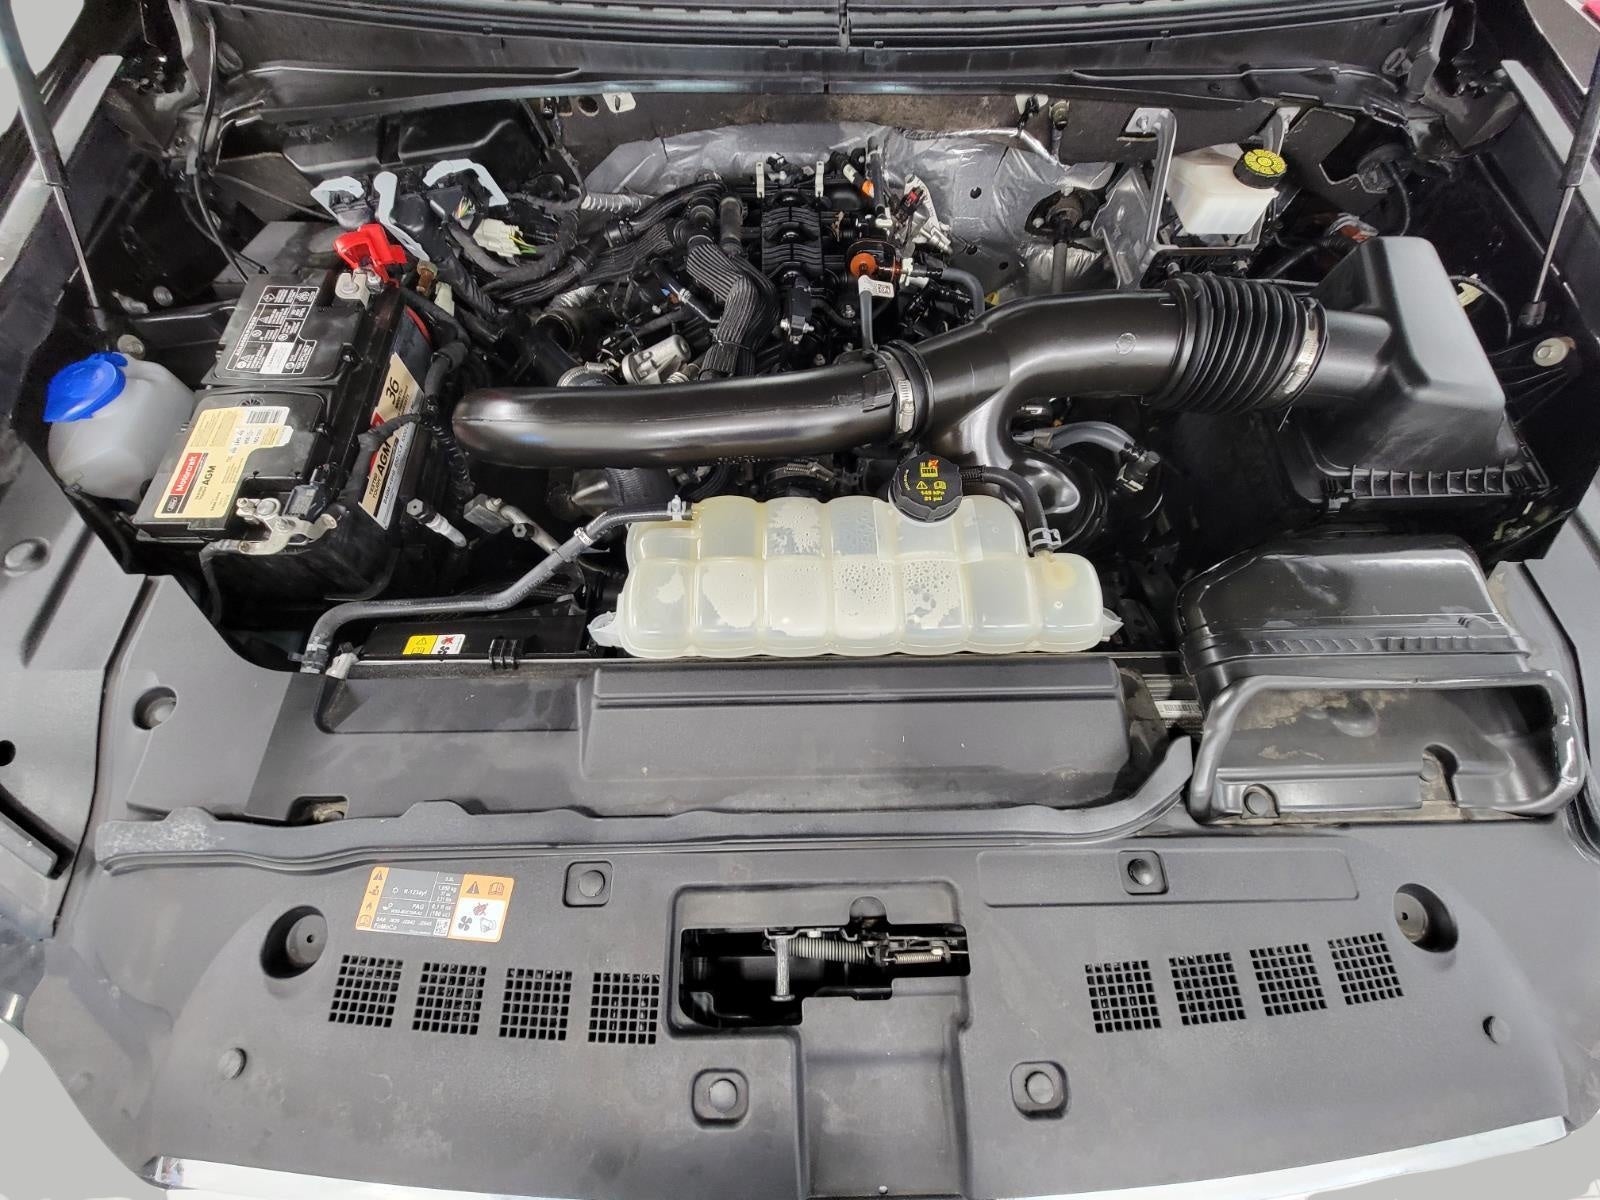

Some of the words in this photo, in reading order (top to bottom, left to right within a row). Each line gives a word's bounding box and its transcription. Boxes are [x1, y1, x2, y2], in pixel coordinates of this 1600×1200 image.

[386, 377, 400, 404] 36
[176, 456, 198, 492] Motorcraft
[377, 442, 392, 476] AGM
[202, 465, 216, 486] AGM
